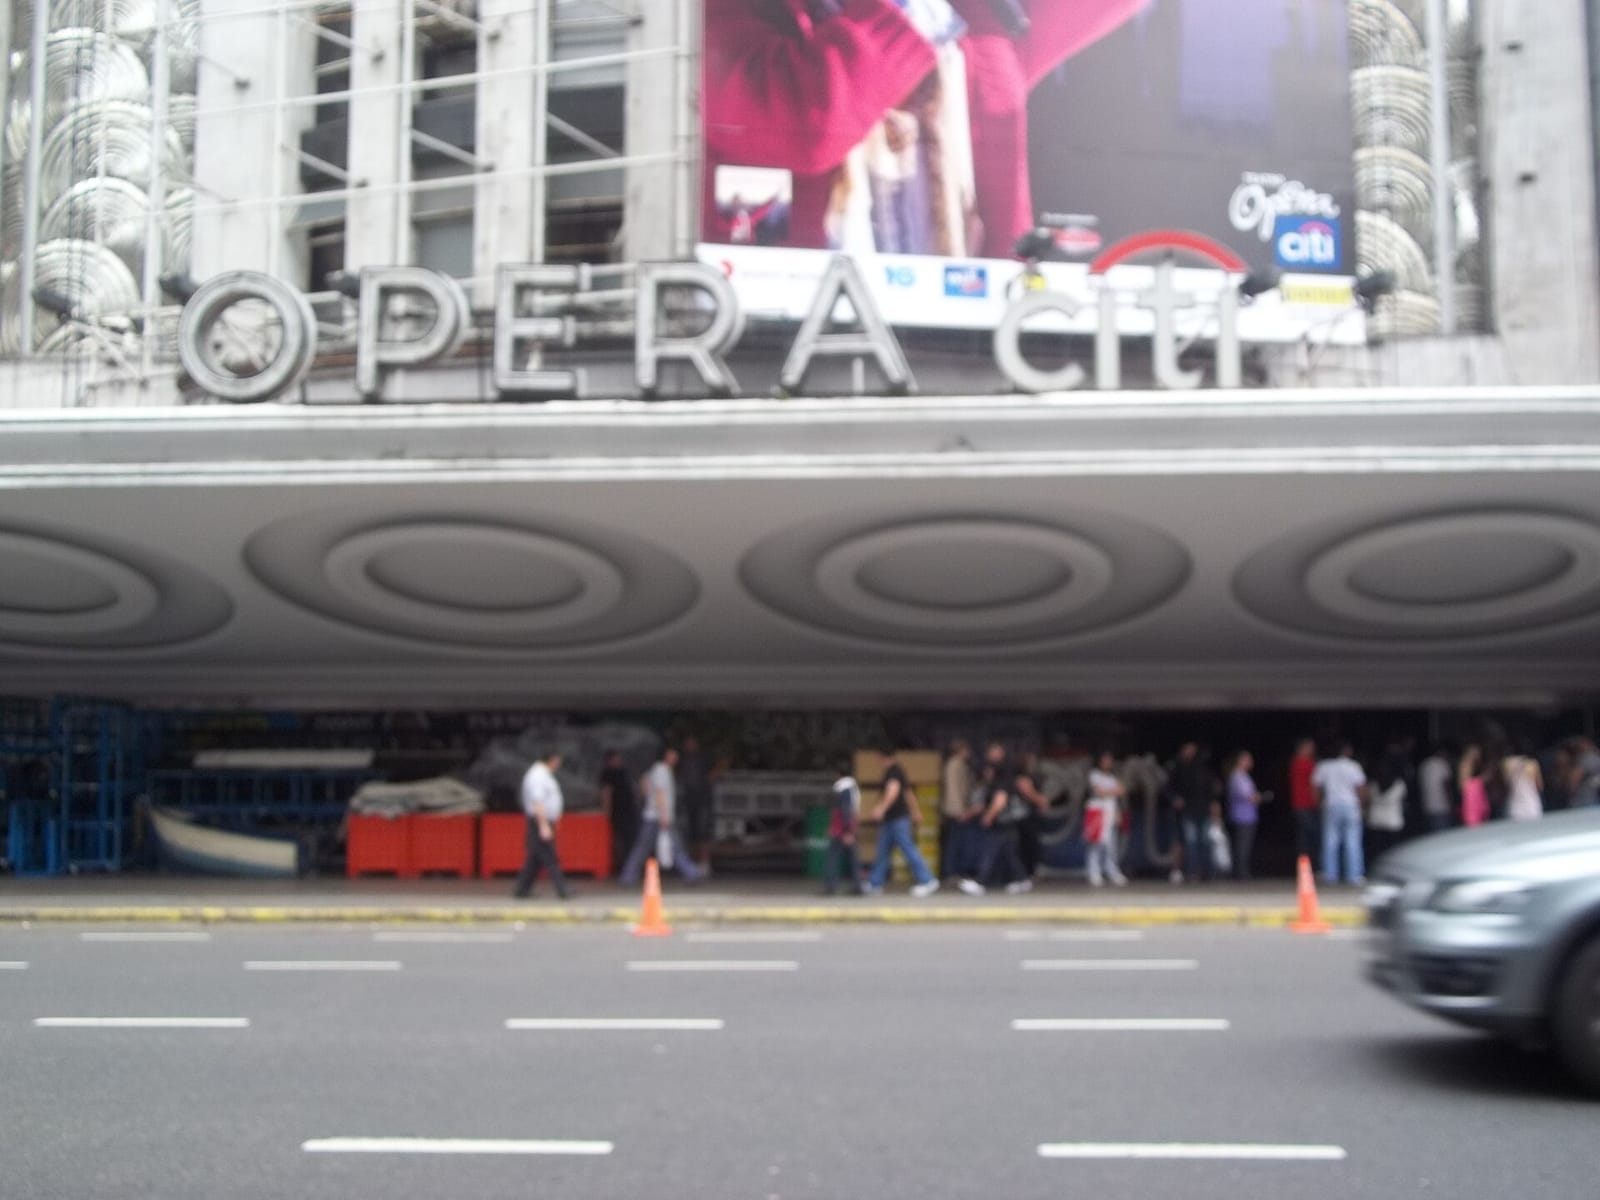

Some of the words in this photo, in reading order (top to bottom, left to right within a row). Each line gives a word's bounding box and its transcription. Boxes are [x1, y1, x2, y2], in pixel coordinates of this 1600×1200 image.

[1278, 229, 1335, 264] citi
[178, 255, 917, 403] OPERA
[993, 254, 1243, 390] citi
